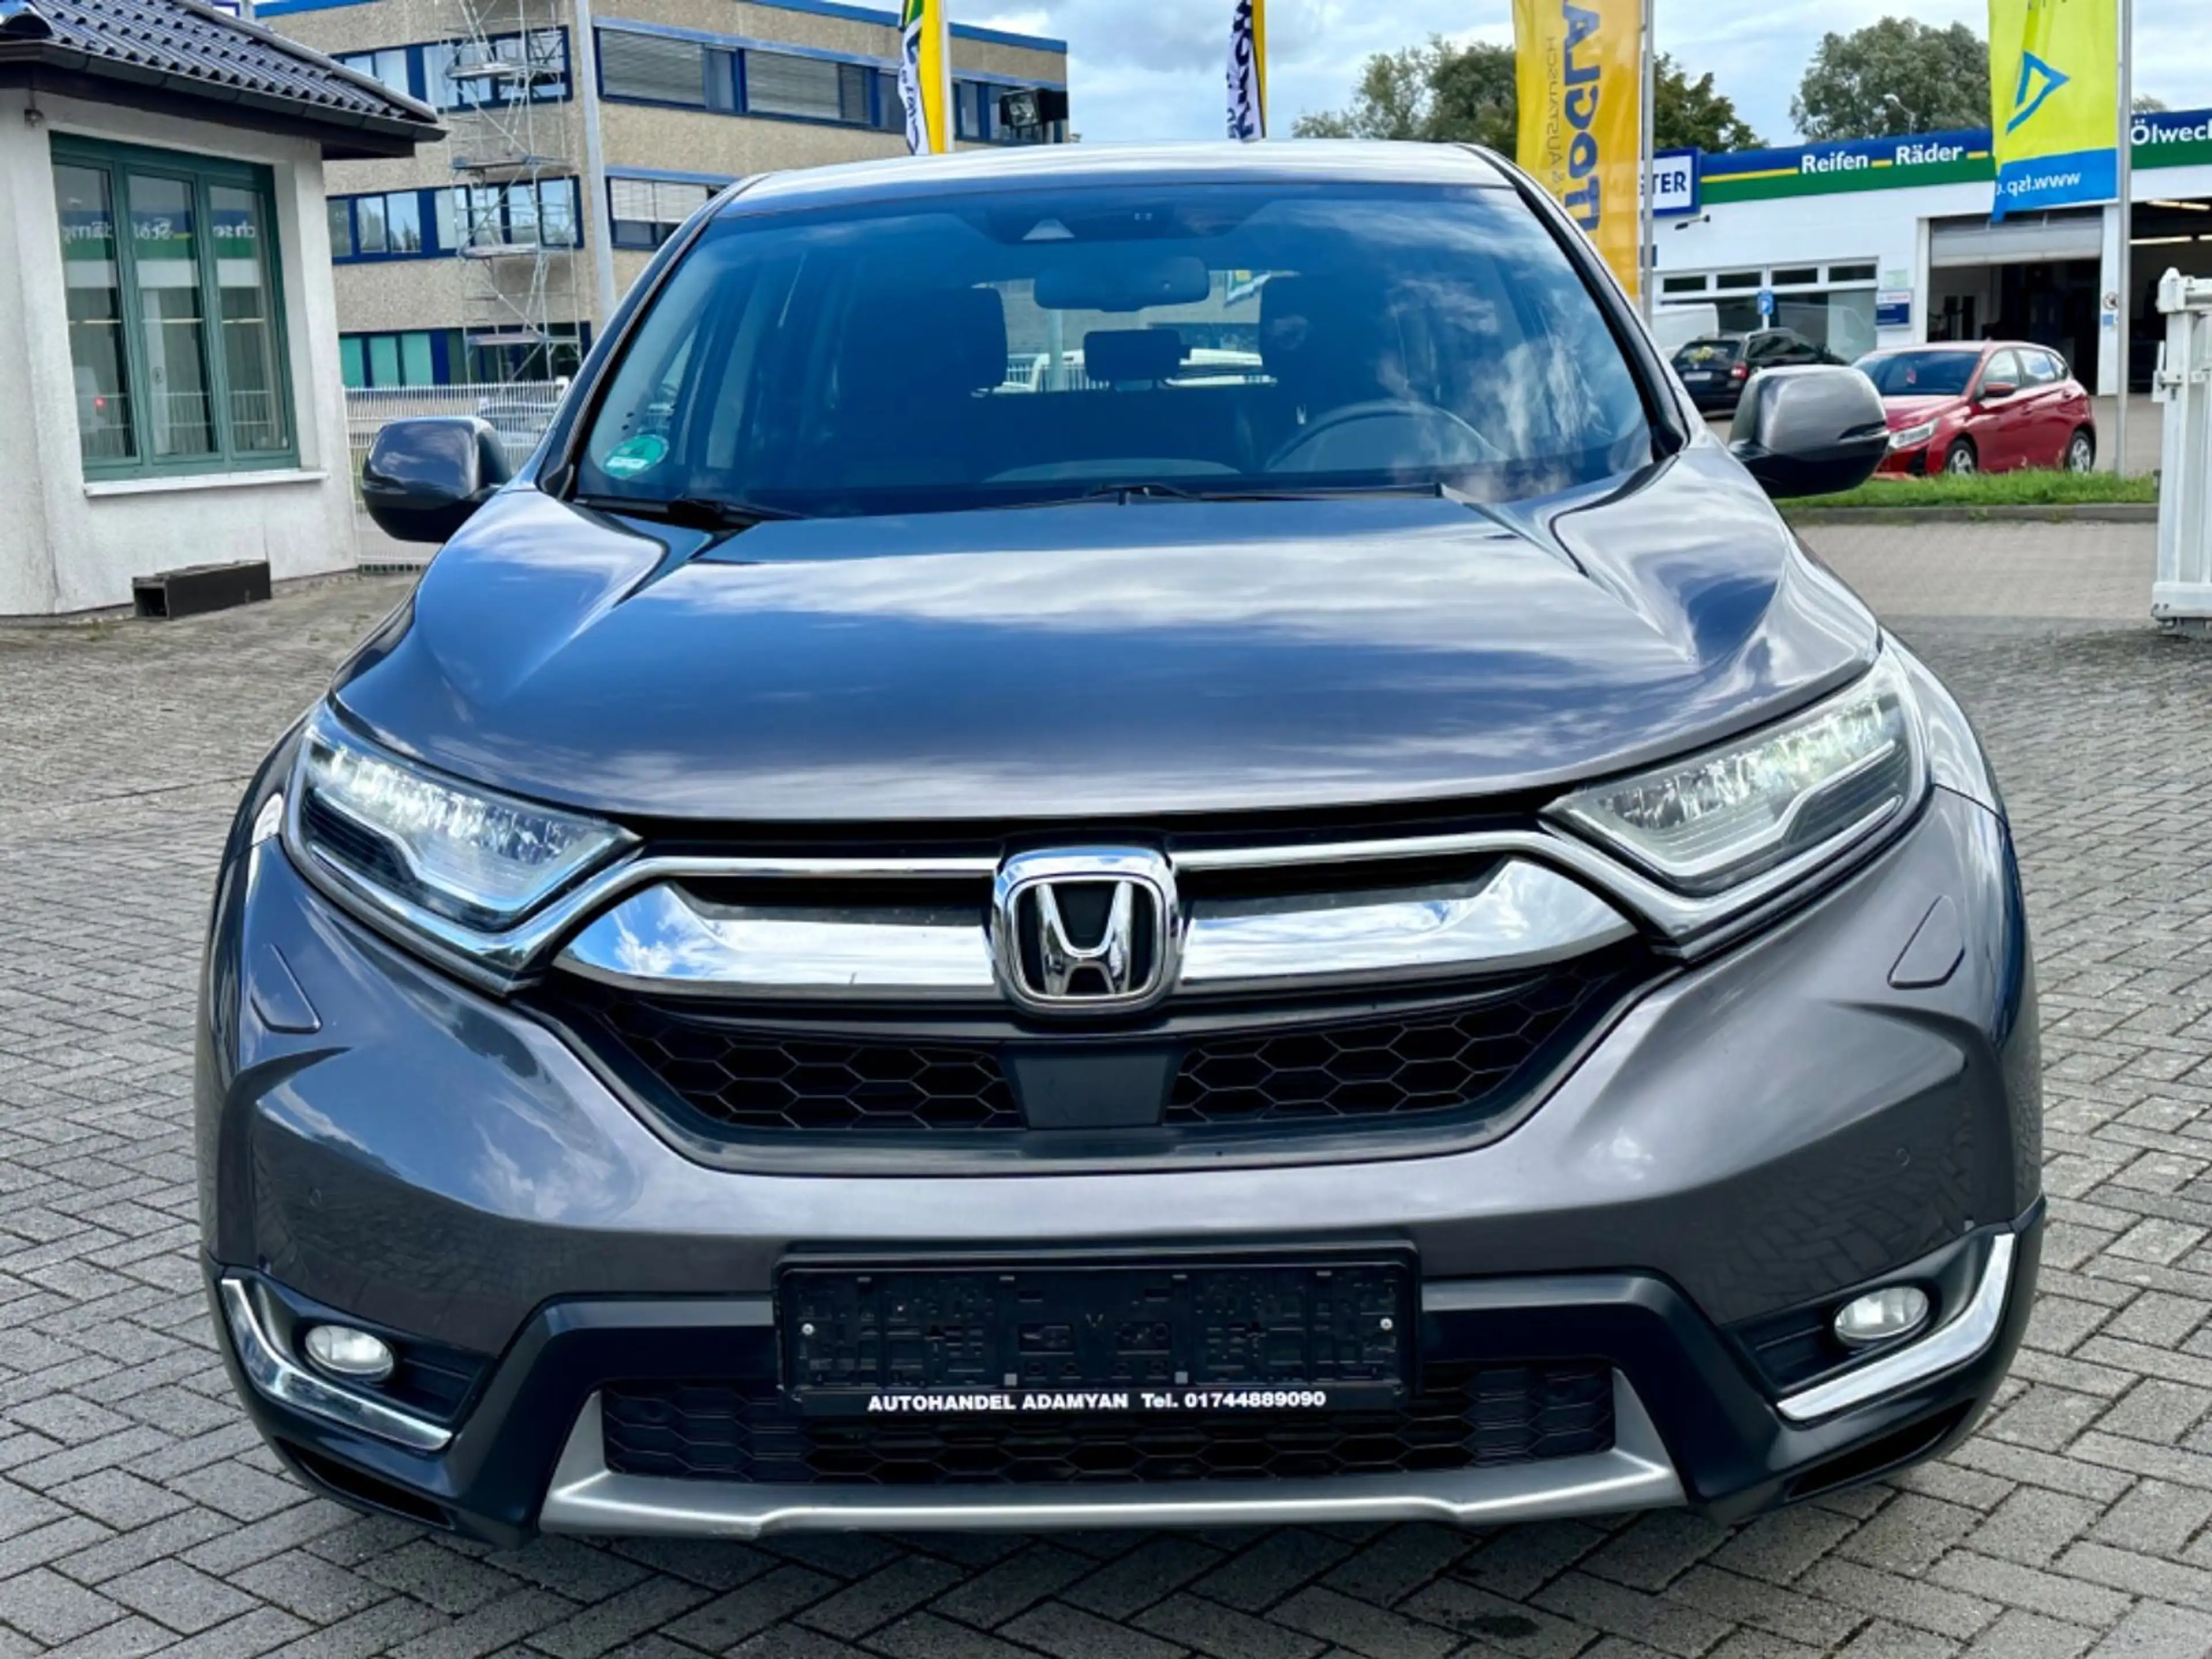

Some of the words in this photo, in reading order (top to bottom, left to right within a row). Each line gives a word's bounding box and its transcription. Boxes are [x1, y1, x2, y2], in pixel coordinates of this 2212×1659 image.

[1801, 151, 1868, 174] Reifen
[1895, 142, 1963, 165] Räder
[868, 1394, 1016, 1411] AUTOHANDEL
[1021, 1393, 1128, 1410] ADAMYAN
[1141, 1393, 1179, 1408] Tel.
[1184, 1391, 1326, 1408] 01744889090
